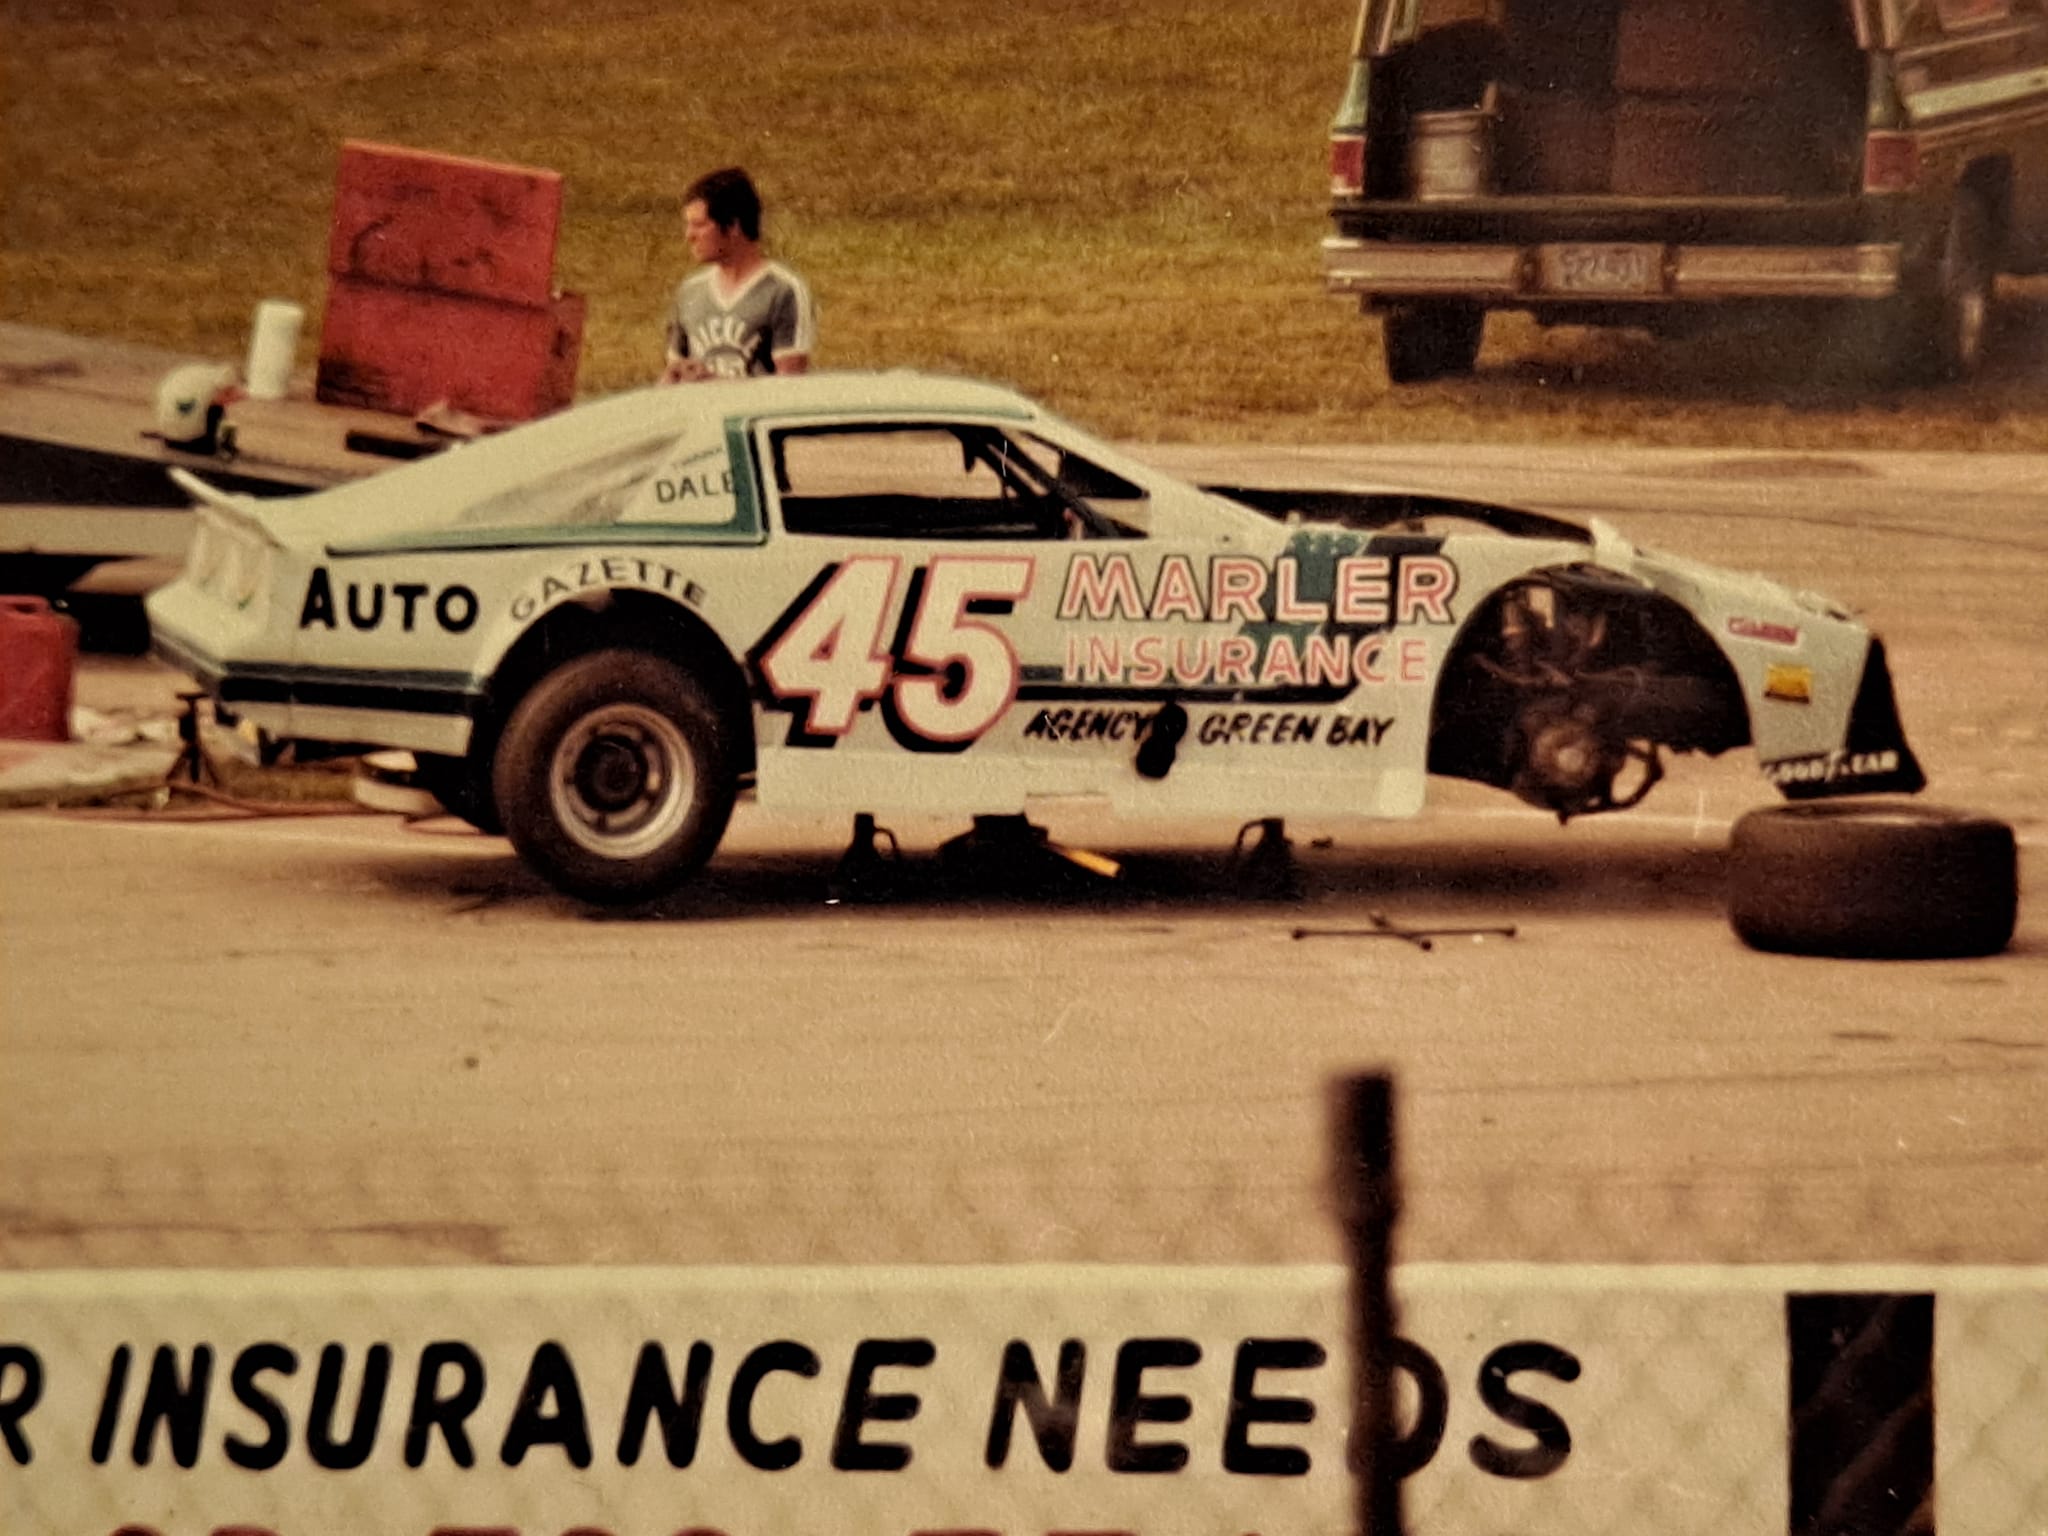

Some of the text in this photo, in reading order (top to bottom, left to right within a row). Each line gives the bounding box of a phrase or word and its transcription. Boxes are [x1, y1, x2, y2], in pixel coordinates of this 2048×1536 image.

[300, 567, 478, 632] AUTO
[511, 557, 706, 621] GAZETTE
[1056, 553, 1460, 624] MARLER
[752, 553, 1036, 750] 45
[1062, 634, 1428, 689] INSURANCE
[1023, 708, 1394, 747] AGENCY GREEN BAY
[91, 1339, 937, 1471] INSURANCE
[985, 1337, 1582, 1480] NEEDS
